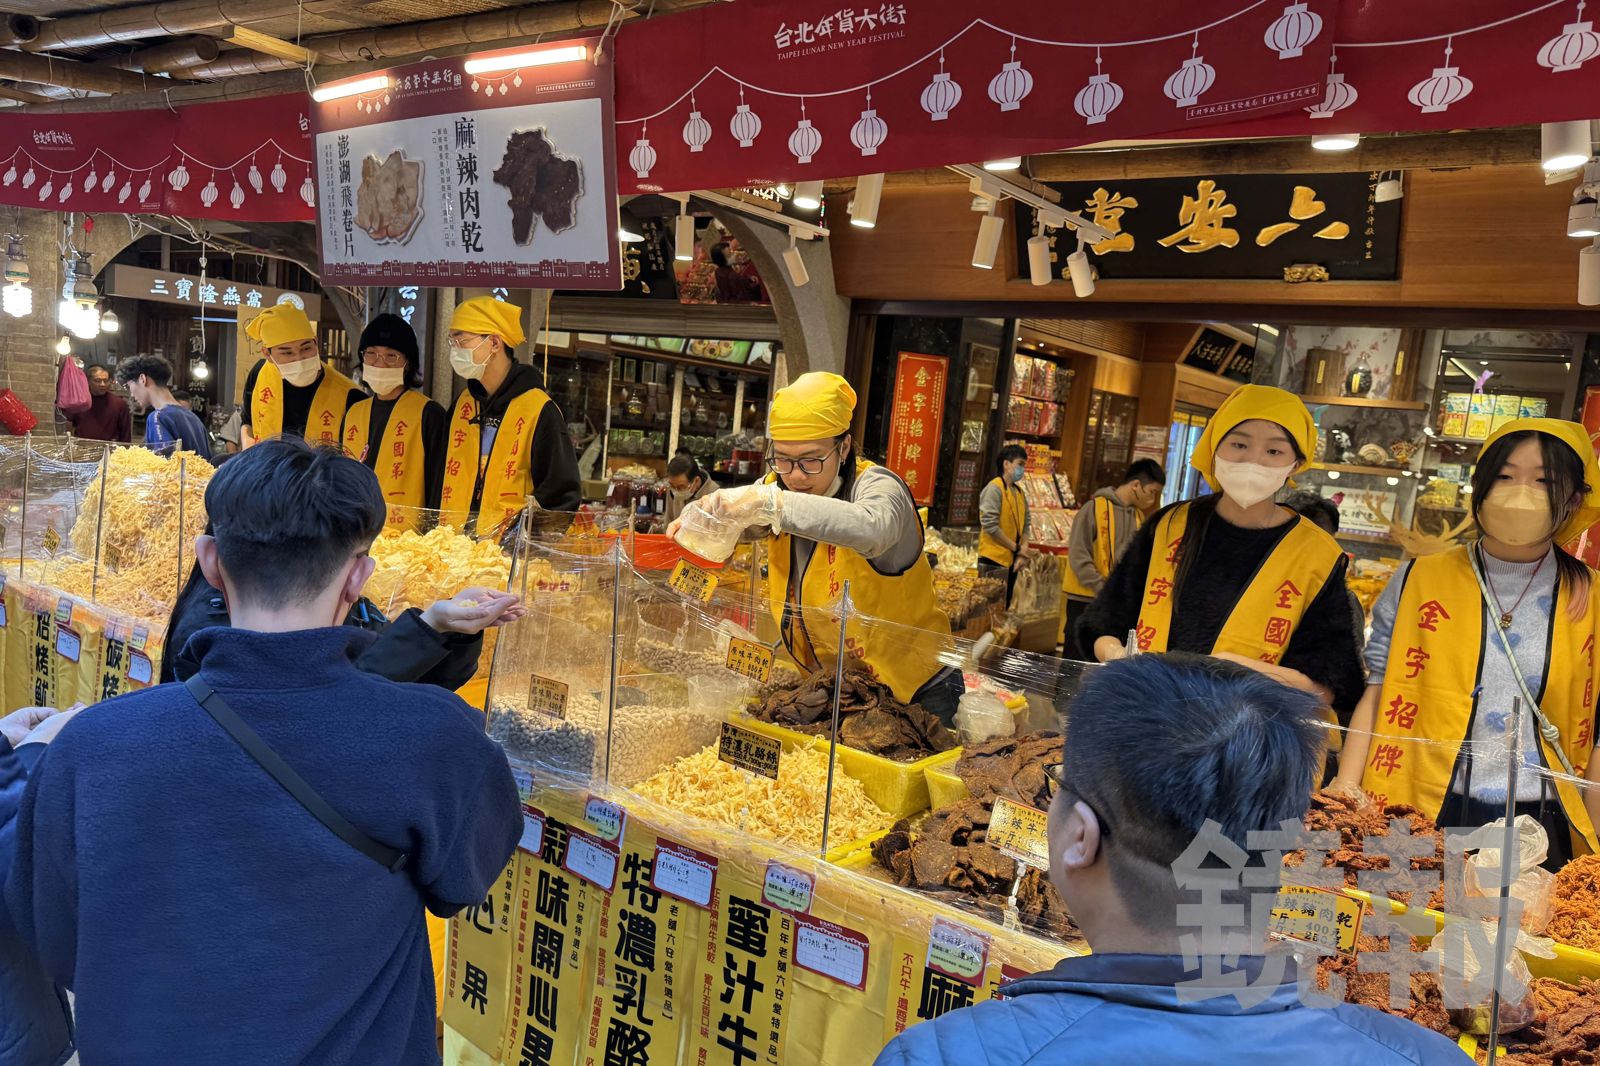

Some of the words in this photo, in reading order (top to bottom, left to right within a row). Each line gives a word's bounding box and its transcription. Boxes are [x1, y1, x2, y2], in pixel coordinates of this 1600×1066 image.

[773, 3, 907, 49] 台北年貨大街
[777, 51, 801, 61] TAIPEI
[801, 45, 826, 56] LUNAR
[827, 42, 845, 51] NEW
[846, 37, 867, 47] YEAR
[868, 29, 905, 43] FESTIVAL
[337, 134, 354, 257] 澎湖飛卷片
[455, 116, 485, 254] 麻辣肉乾
[150, 277, 263, 308] 三寶隆燕窩
[387, 420, 409, 524] 全國第一品
[603, 852, 662, 1066] 特濃乳酪
[716, 893, 772, 1066] 蜜汁牛
